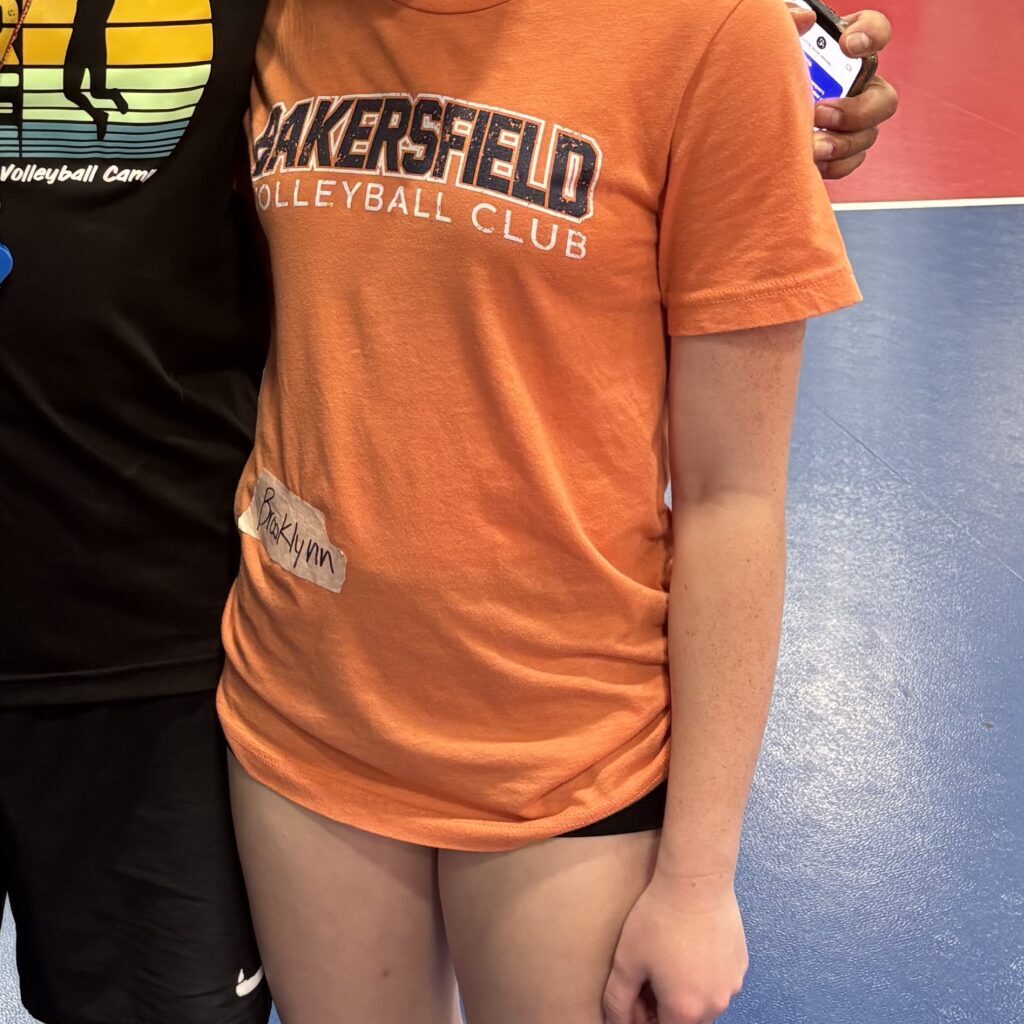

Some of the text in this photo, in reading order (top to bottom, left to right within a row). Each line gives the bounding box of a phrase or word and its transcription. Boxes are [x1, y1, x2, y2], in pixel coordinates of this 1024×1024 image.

[0, 163, 96, 185] Volleyball
[255, 179, 588, 260] OLLEYBALL CLUB
